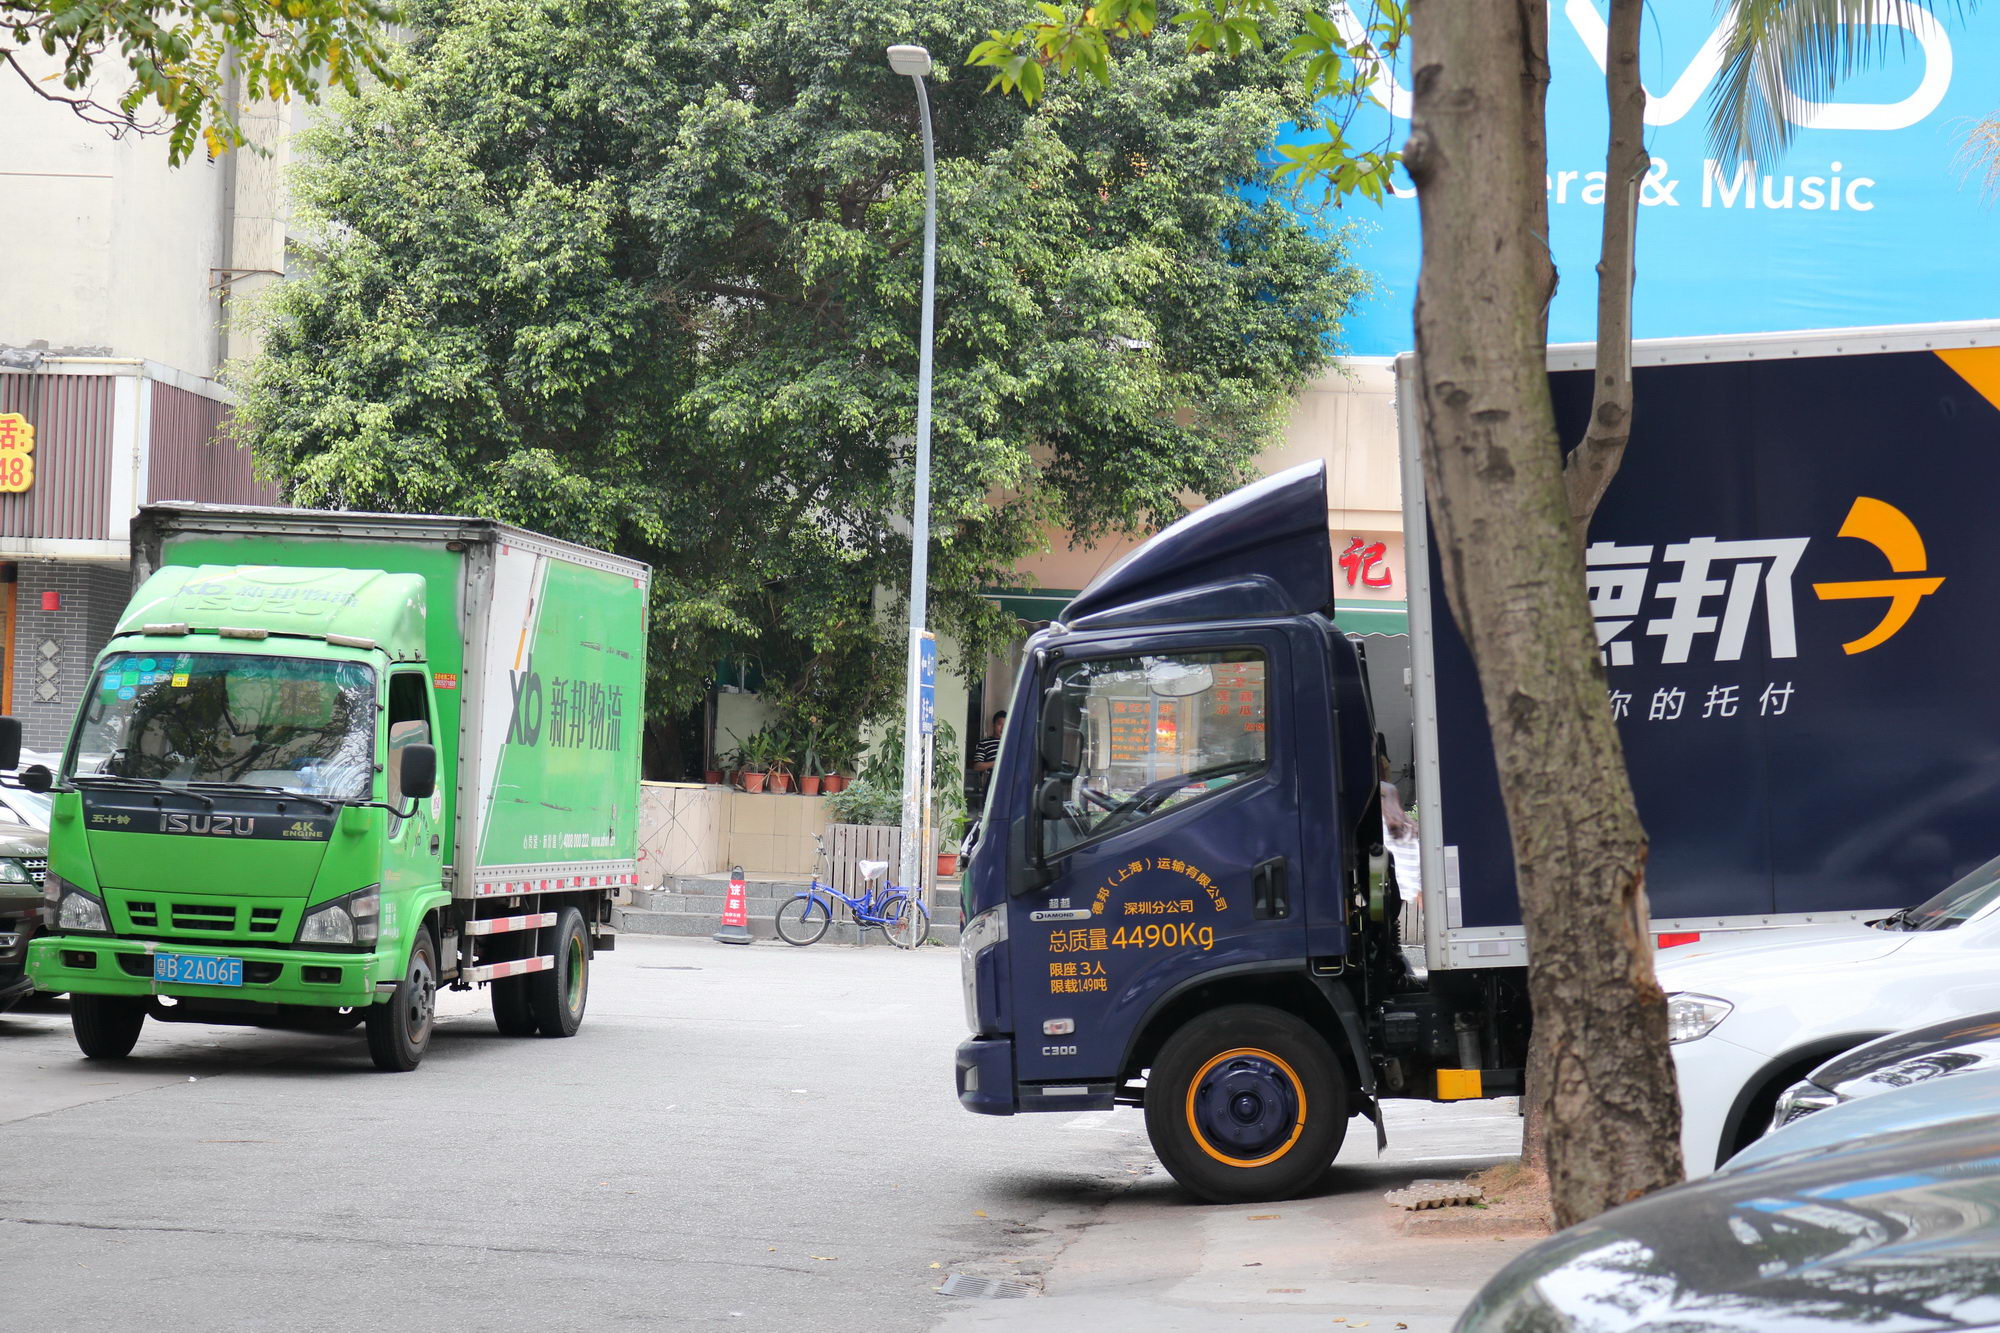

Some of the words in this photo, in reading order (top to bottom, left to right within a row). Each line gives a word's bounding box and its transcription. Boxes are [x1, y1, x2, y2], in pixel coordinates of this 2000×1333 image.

[1701, 158, 1876, 212] Music
[1338, 536, 1393, 589] 记
[549, 676, 623, 752] 新邦物流
[91, 813, 131, 825] 五十铃
[159, 813, 255, 836] ISUZU
[291, 821, 314, 831] 4K
[282, 830, 323, 838] ENGINE
[1124, 899, 1194, 915] 深圳分公司
[1049, 928, 1109, 952] 总质量
[1112, 922, 1214, 951] 4490Kg
[1042, 1045, 1078, 1056] C300
